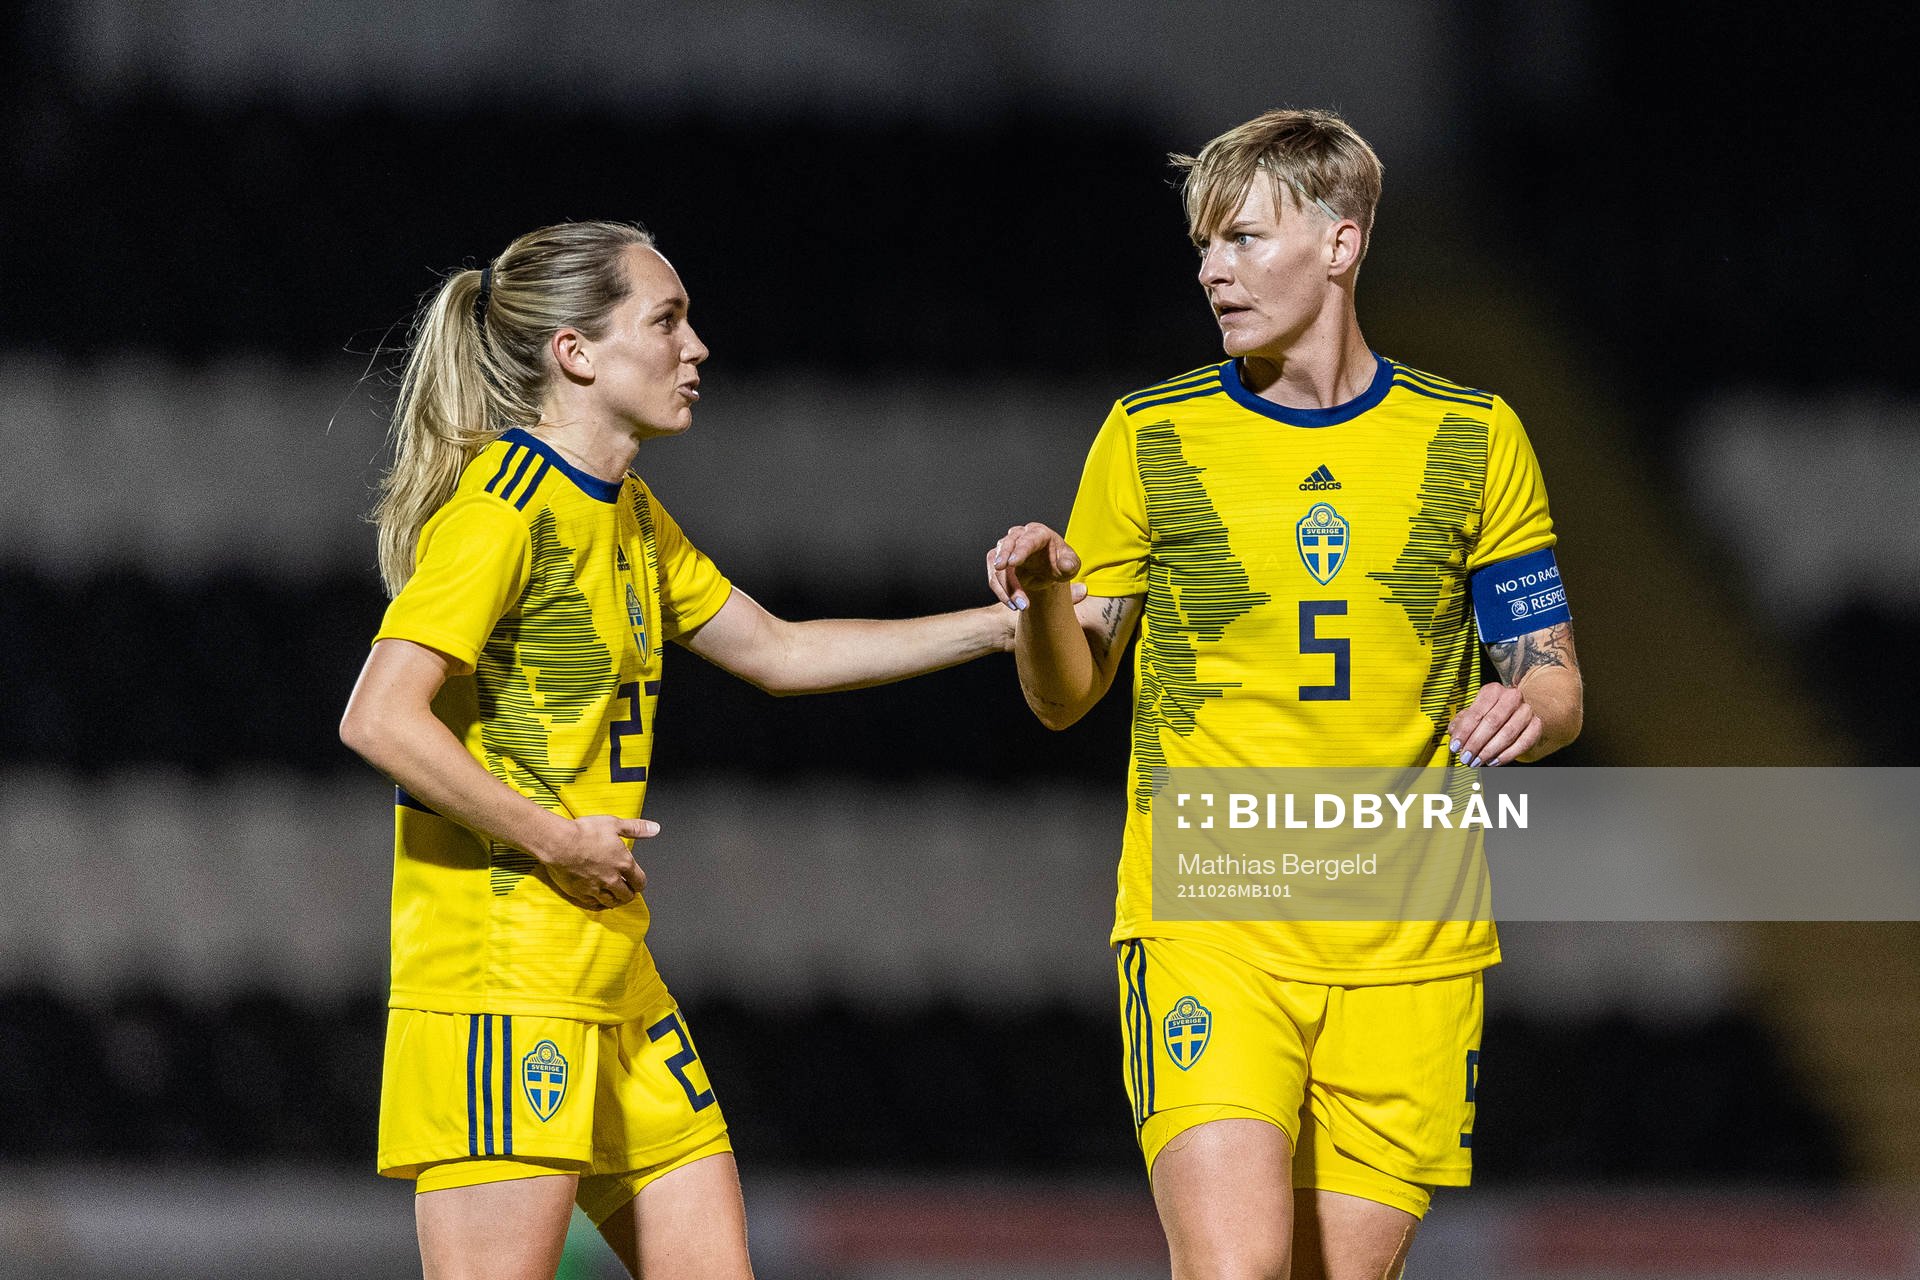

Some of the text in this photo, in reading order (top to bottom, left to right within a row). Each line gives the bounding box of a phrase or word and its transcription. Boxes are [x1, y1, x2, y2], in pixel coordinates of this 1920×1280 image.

[1299, 482, 1342, 491] adidas
[1495, 580, 1518, 595] NO
[1518, 574, 1537, 588] TO
[1530, 589, 1567, 611] RESPEC
[1298, 600, 1351, 701] 5
[1172, 1018, 1202, 1026] SVERIGE
[531, 1064, 560, 1072] SVERIGE
